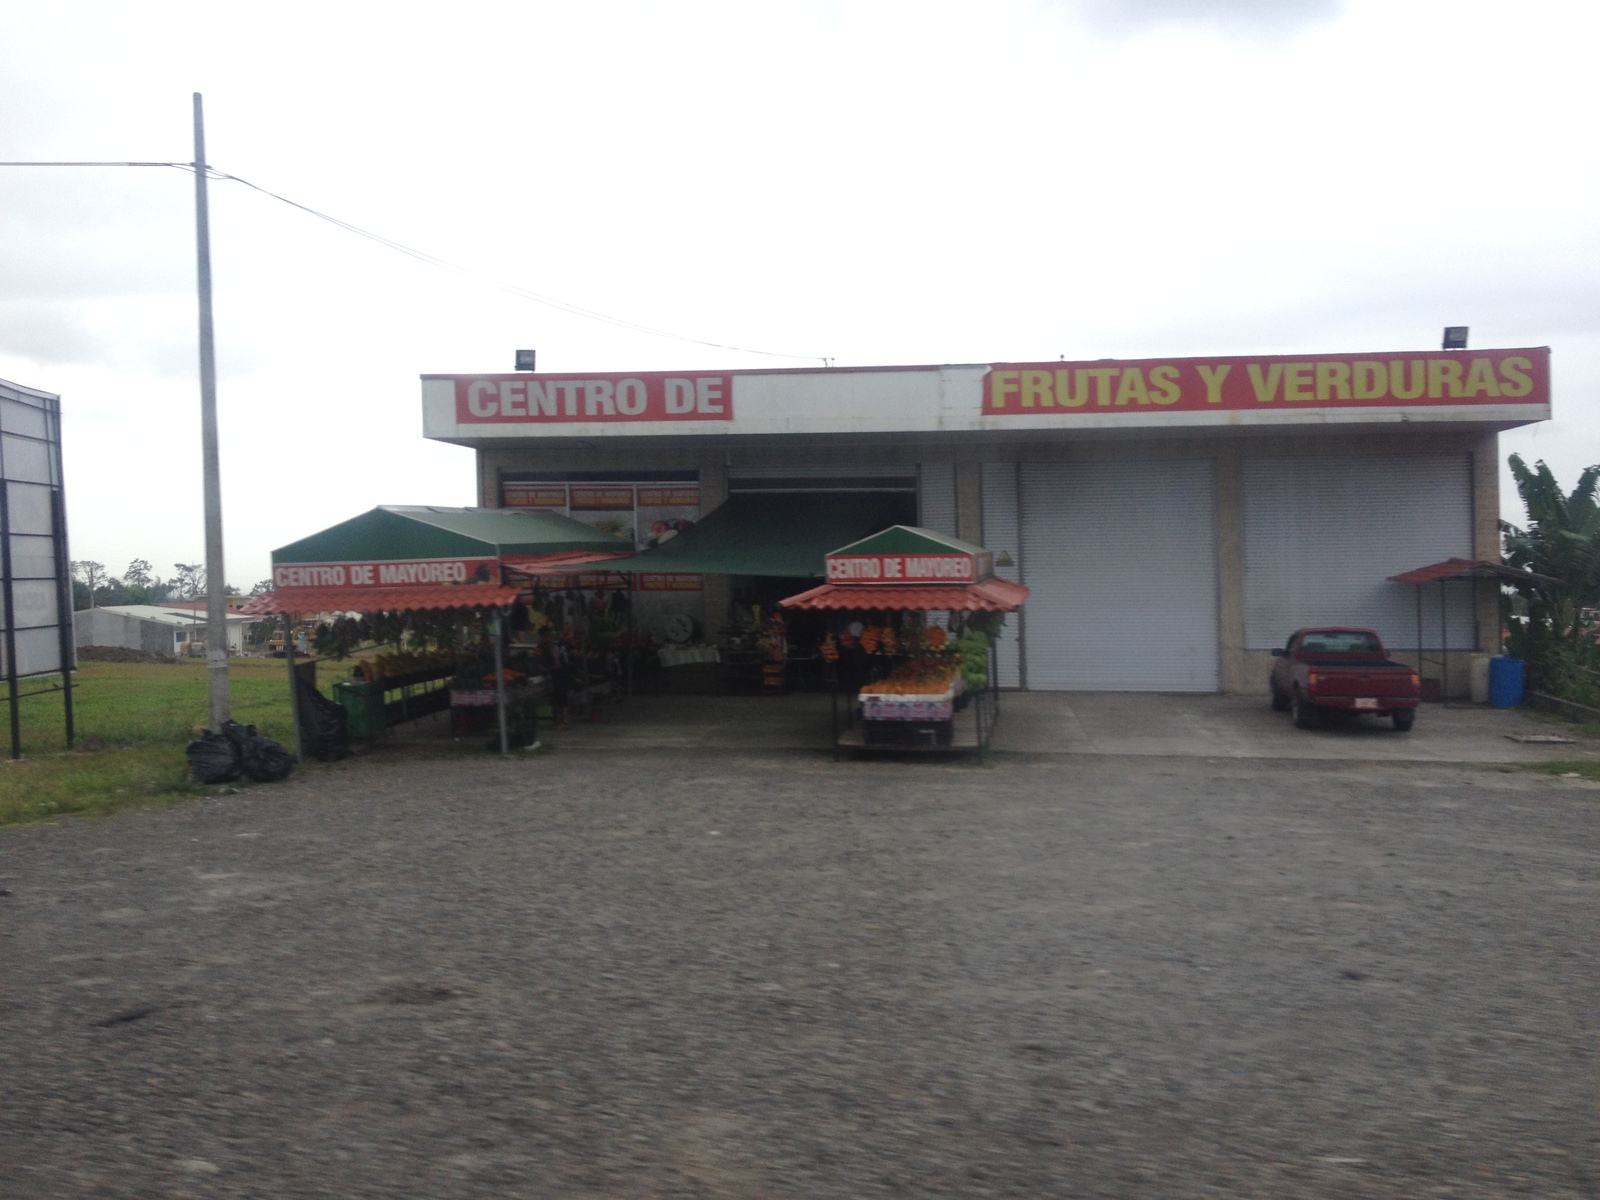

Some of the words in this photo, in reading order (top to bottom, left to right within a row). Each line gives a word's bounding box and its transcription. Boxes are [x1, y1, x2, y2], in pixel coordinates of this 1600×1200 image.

[467, 378, 648, 418] CENTRO
[664, 377, 725, 414] DE
[991, 365, 1182, 409] FRUTAS
[1199, 365, 1232, 403] Y
[1248, 357, 1534, 401] VERDURAS
[275, 565, 345, 587] CENTRO
[351, 565, 374, 585] DE
[379, 561, 467, 584] MAYOREO
[826, 558, 881, 579] CENTRO
[883, 558, 903, 578] DE
[905, 557, 972, 578] MAYOREO
